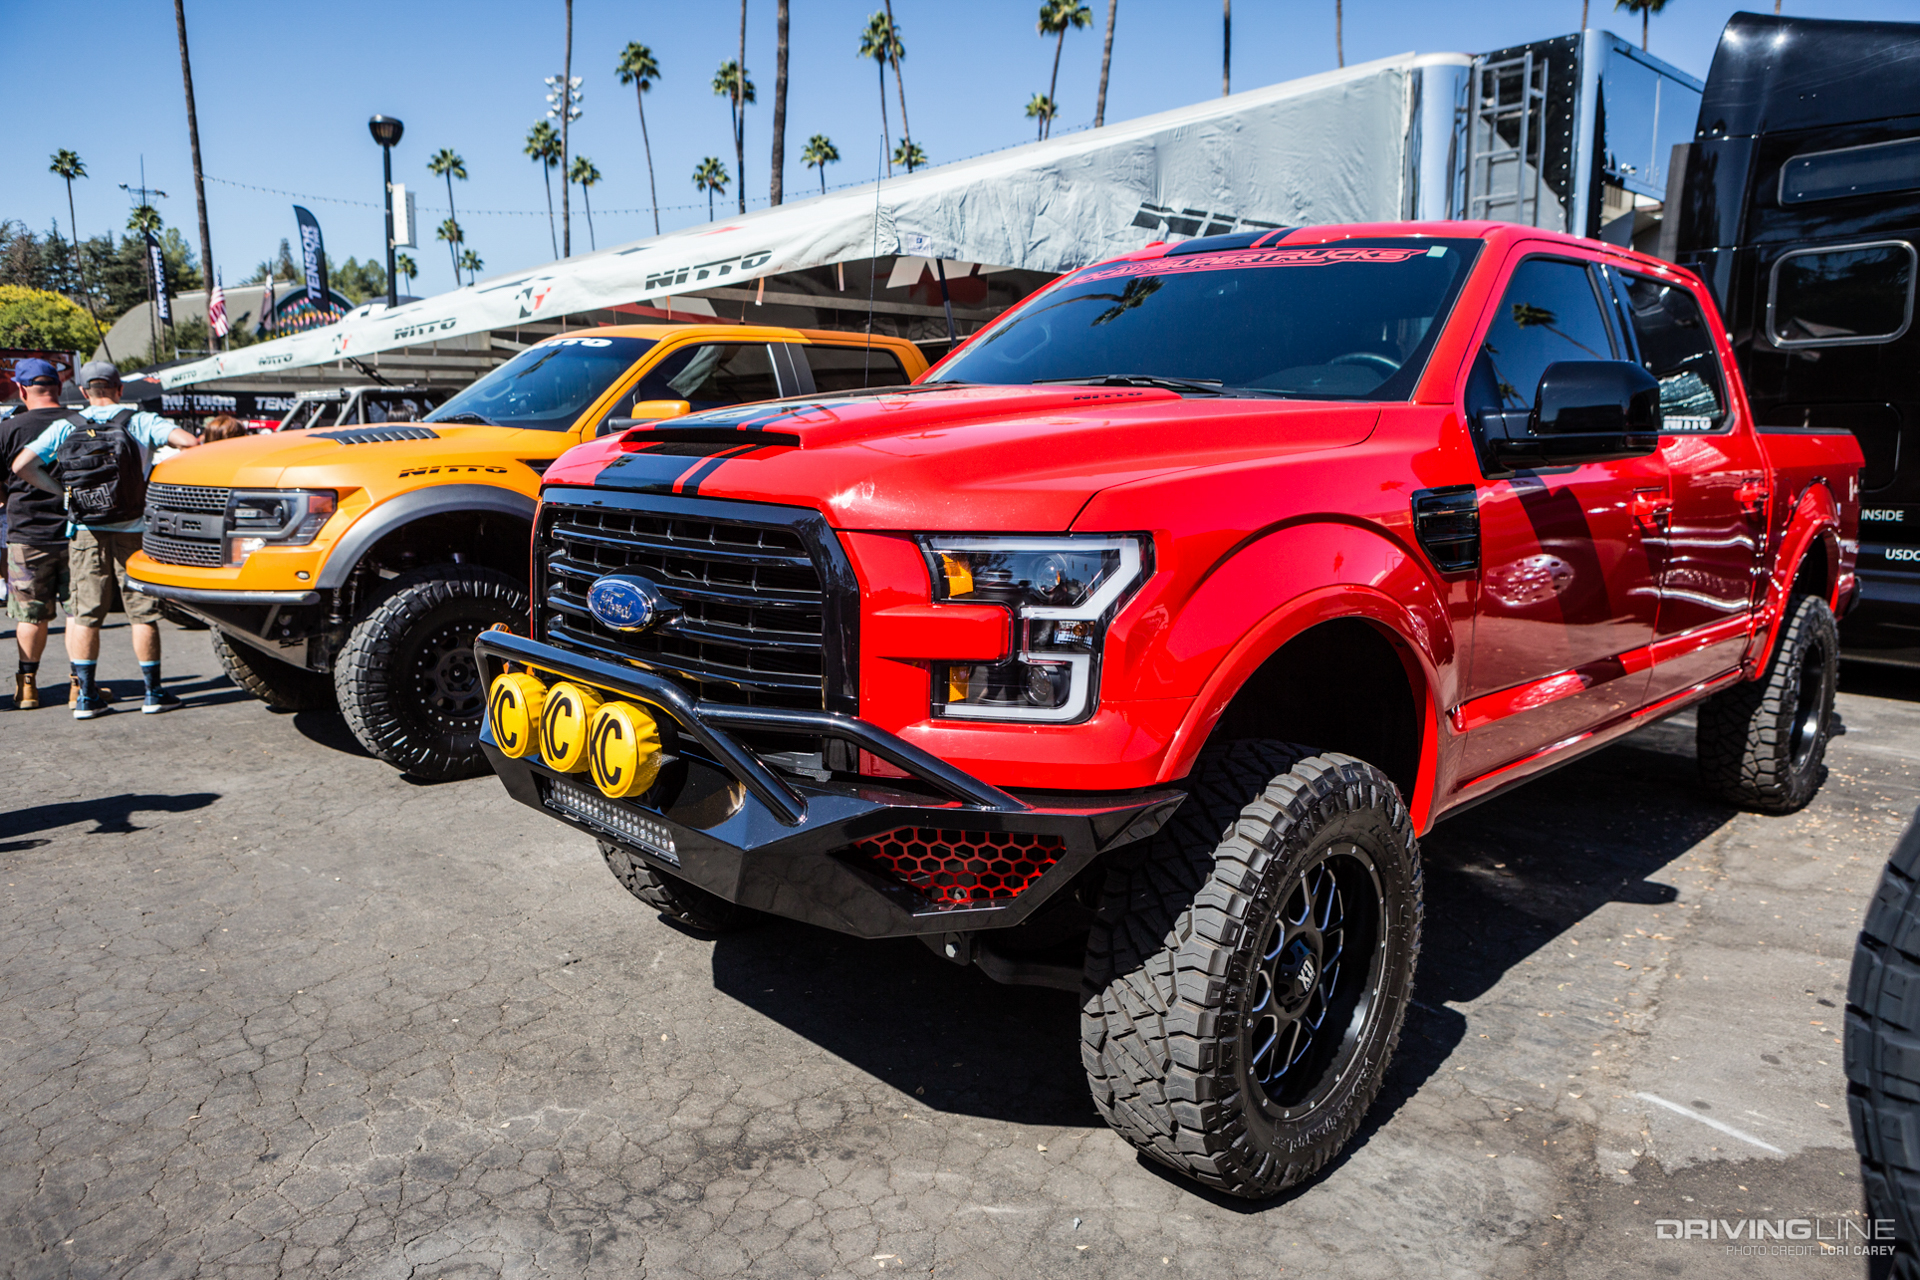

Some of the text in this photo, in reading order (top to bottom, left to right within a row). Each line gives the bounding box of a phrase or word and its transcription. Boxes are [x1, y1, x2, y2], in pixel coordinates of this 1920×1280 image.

[301, 223, 322, 300] TENSOR
[645, 249, 773, 290] NITTO
[394, 317, 457, 340] NITTO
[1074, 392, 1143, 400] NITTO
[1663, 415, 1712, 430] NITTO
[398, 464, 508, 478] NITTO
[1861, 508, 1905, 522] INSIDE
[598, 590, 634, 620] Ford
[488, 683, 517, 750] KC
[540, 690, 572, 761] KC
[588, 712, 623, 788] KC
[1297, 959, 1315, 991] XD
